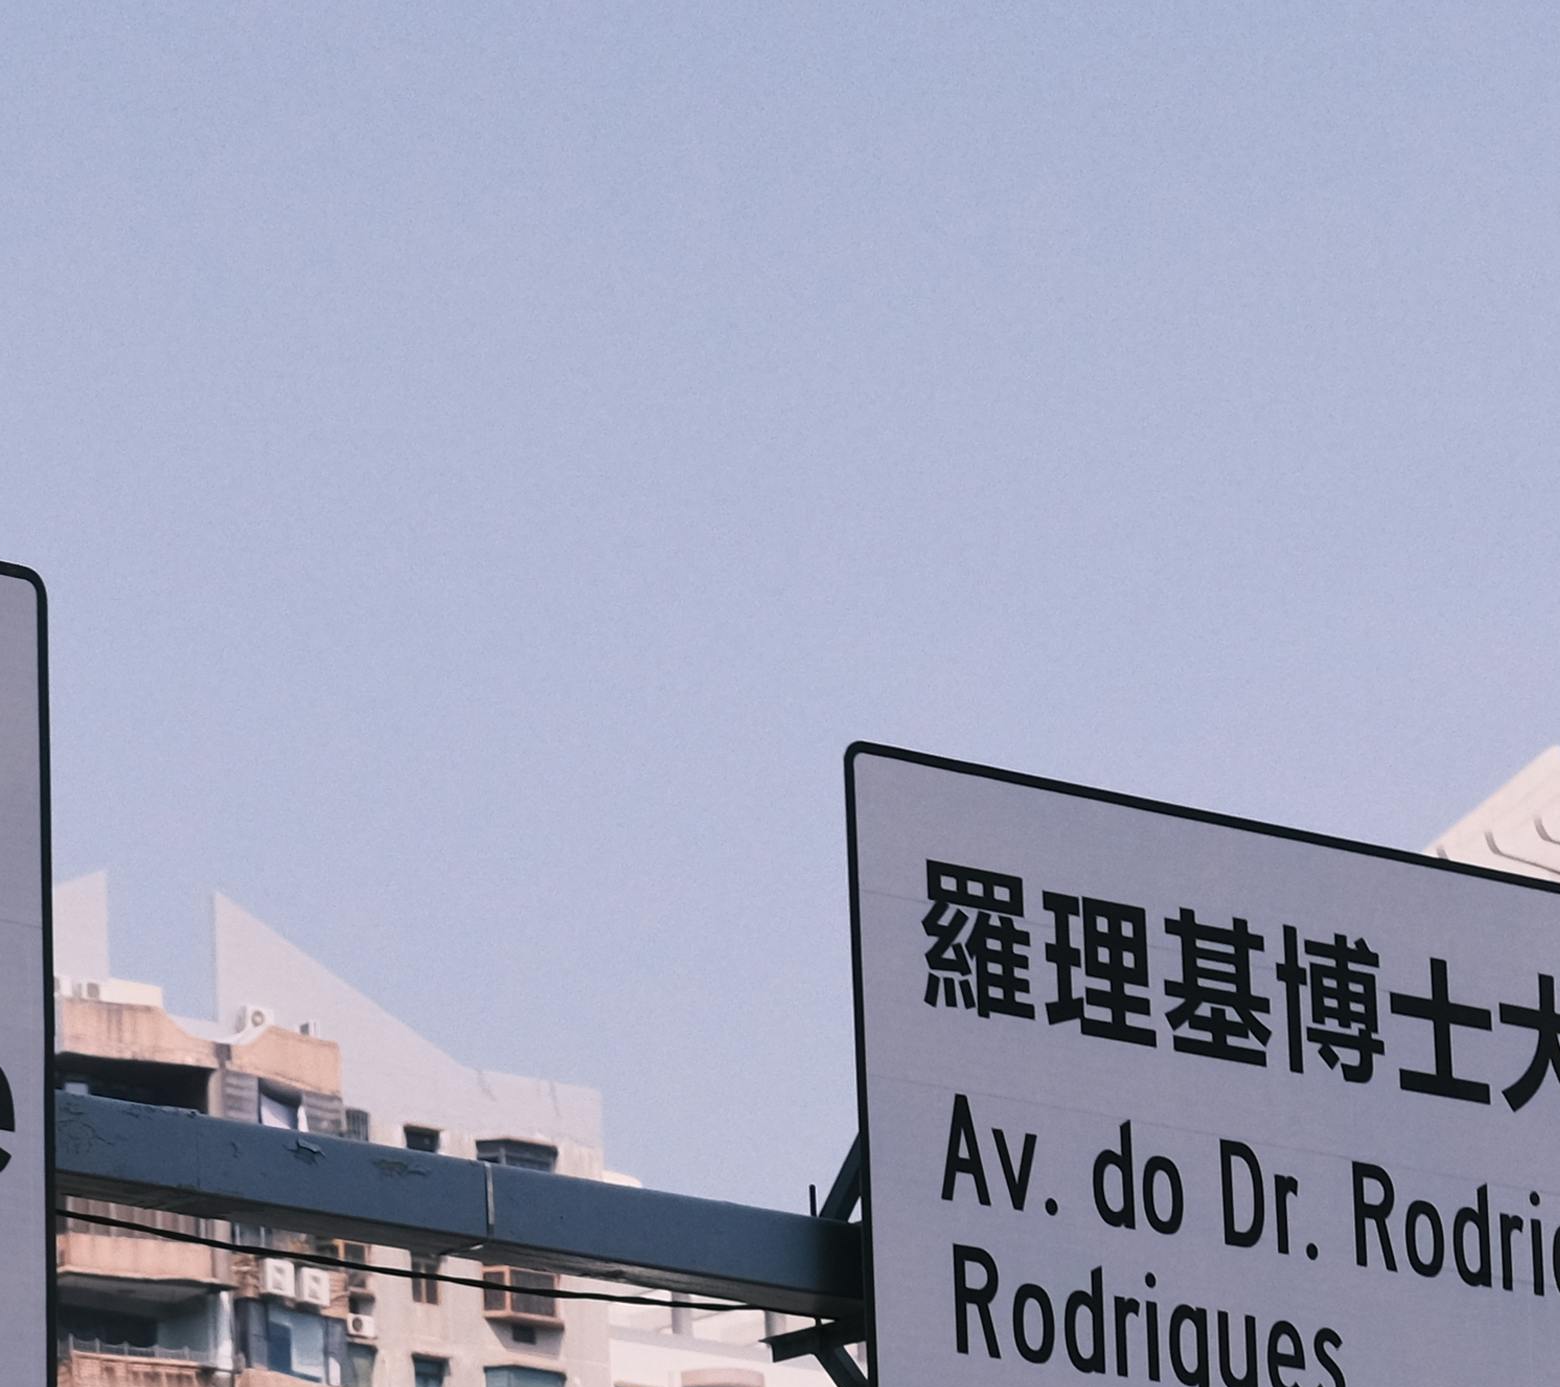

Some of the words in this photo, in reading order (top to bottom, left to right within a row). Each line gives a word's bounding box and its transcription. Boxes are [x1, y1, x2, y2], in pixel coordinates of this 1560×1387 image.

[942, 1094, 1058, 1215] Av.
[1093, 1120, 1183, 1234] do
[1220, 1139, 1319, 1261] Dr.
